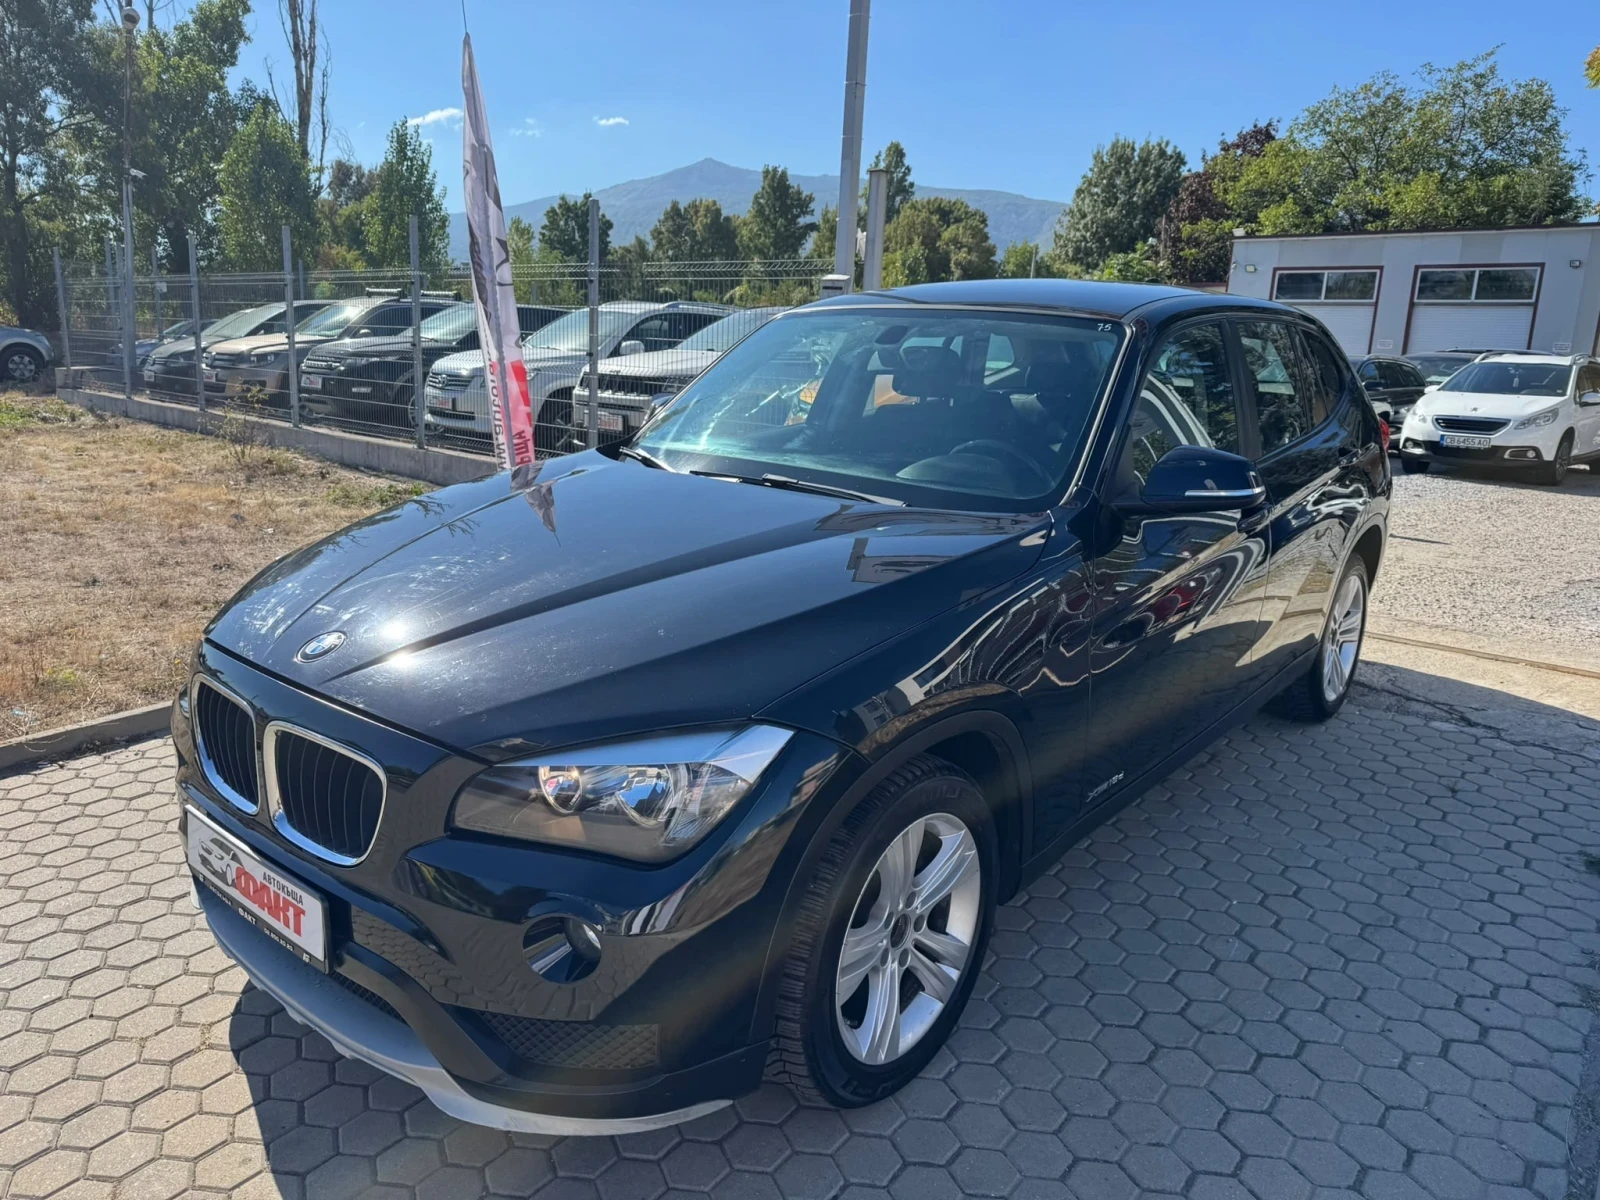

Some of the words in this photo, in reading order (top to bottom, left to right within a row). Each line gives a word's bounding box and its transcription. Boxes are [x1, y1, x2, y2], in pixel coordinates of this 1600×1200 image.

[1097, 323, 1112, 332] 75
[1456, 437, 1476, 446] 6455
[262, 872, 304, 906] АВТОКЪЩА
[235, 866, 306, 938] ФАКТ
